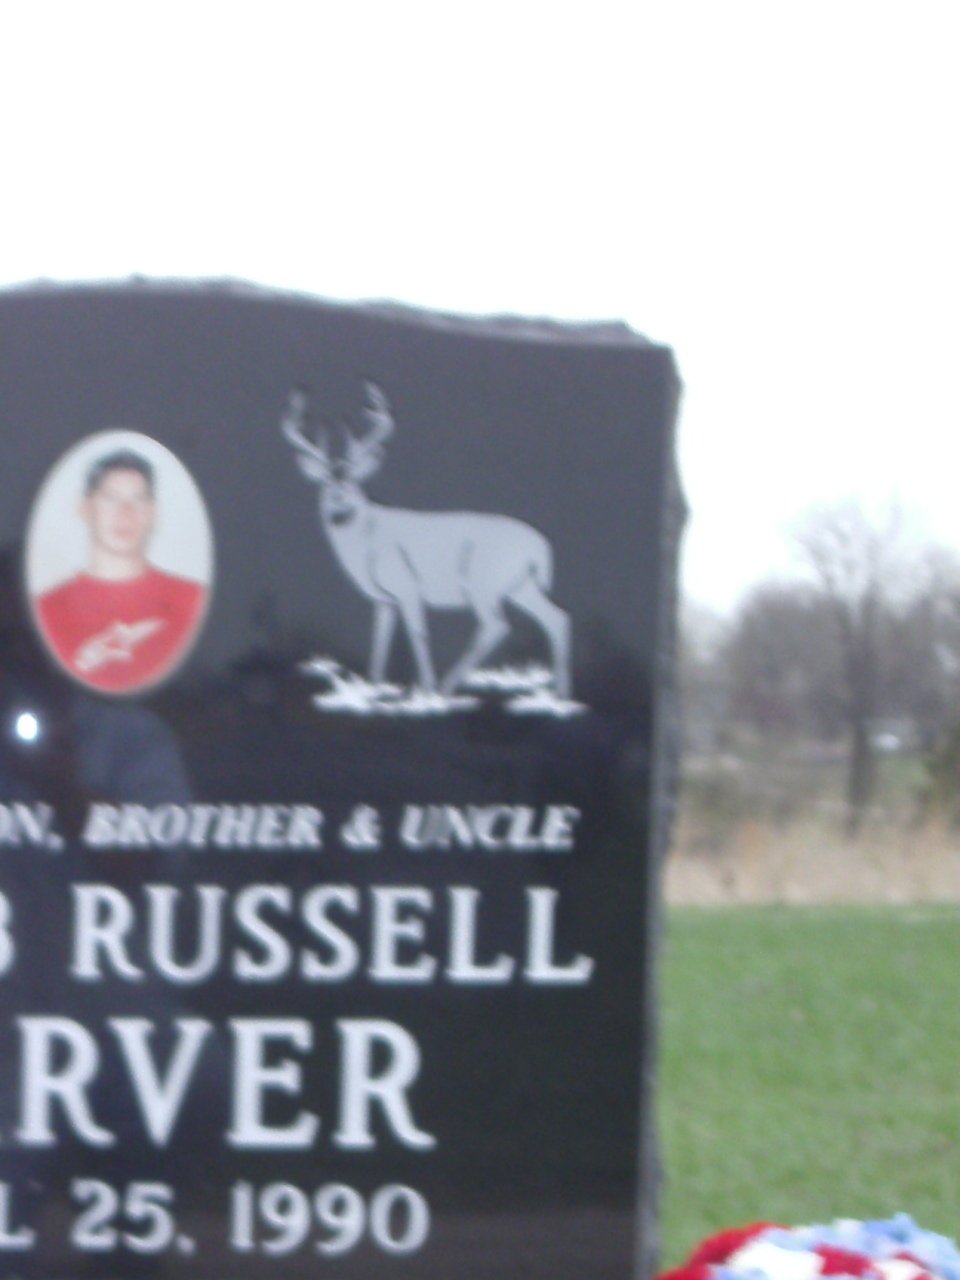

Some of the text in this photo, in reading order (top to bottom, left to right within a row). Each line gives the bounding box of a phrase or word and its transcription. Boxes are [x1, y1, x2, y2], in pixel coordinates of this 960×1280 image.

[81, 802, 325, 849] BROTHER
[339, 804, 381, 850] &
[398, 804, 580, 850] UNCLE
[69, 883, 594, 984] RUSSELL
[229, 1182, 431, 1256] 1990
